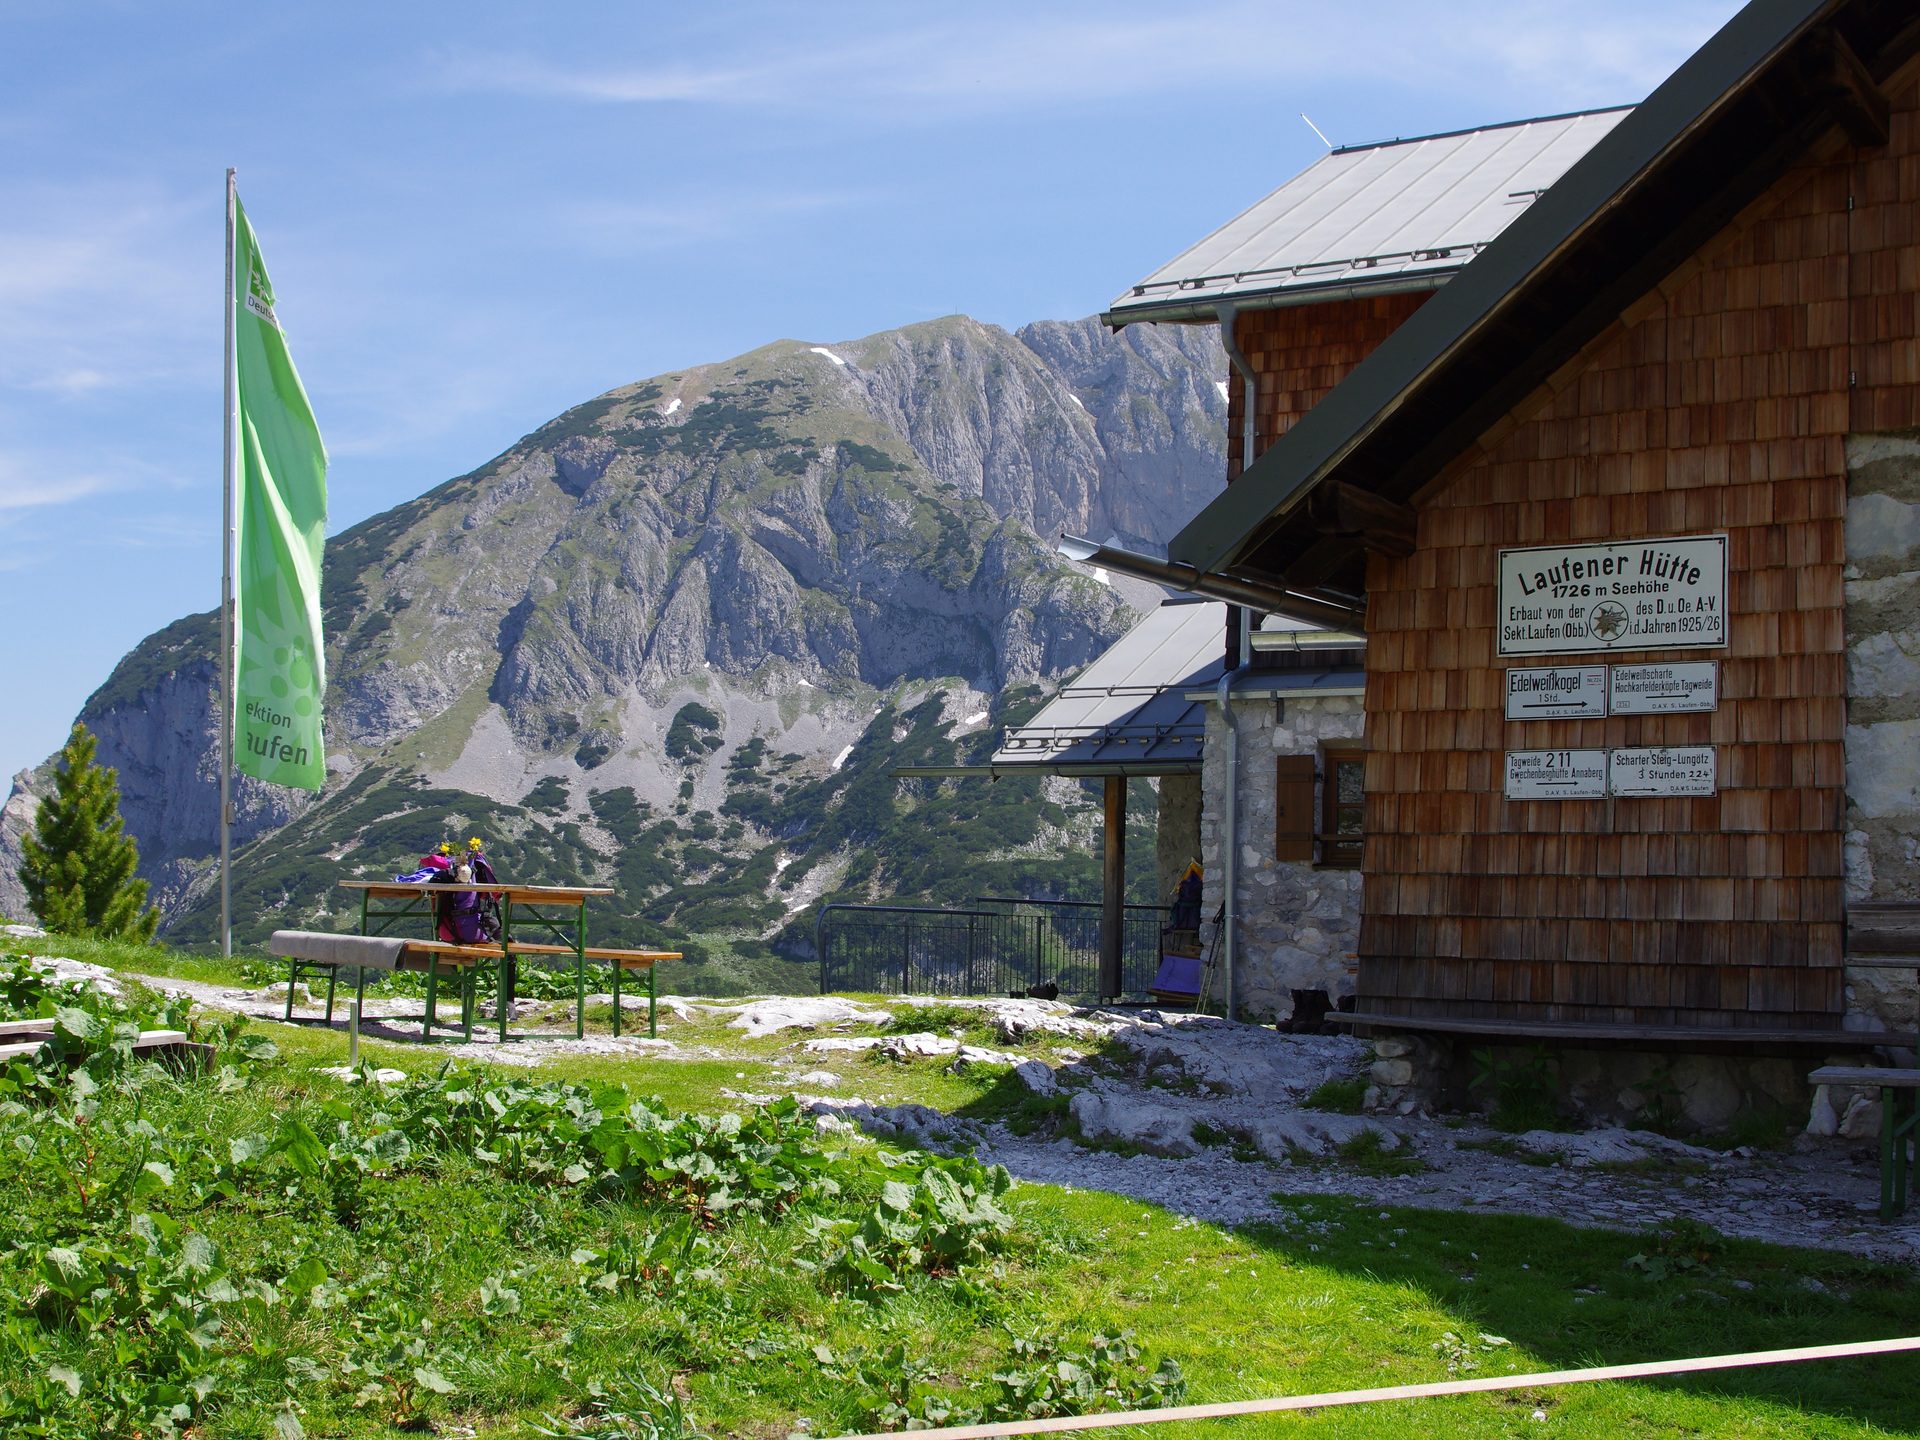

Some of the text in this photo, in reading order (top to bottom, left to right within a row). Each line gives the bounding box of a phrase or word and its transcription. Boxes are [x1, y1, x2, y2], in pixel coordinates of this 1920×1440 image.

[1518, 549, 1701, 597] Laufener Hütte
[1551, 580, 1670, 599] 1726 m Seehöhe
[1509, 603, 1586, 622] Erbaut von der
[1636, 600, 1654, 615] des
[1562, 621, 1589, 640] (Obb.)
[1678, 615, 1720, 633] 1925/26
[1510, 671, 1582, 694] Edelweißkogel
[1681, 678, 1712, 693] Tagweide
[1538, 693, 1561, 703] 1 Std.
[245, 701, 291, 728] ektion
[246, 731, 308, 765] aufen
[1510, 752, 1571, 770] Tagweide 211
[1571, 766, 1603, 780] Annaberg
[1638, 770, 1644, 780] 3
[1648, 769, 1686, 780] Stunden
